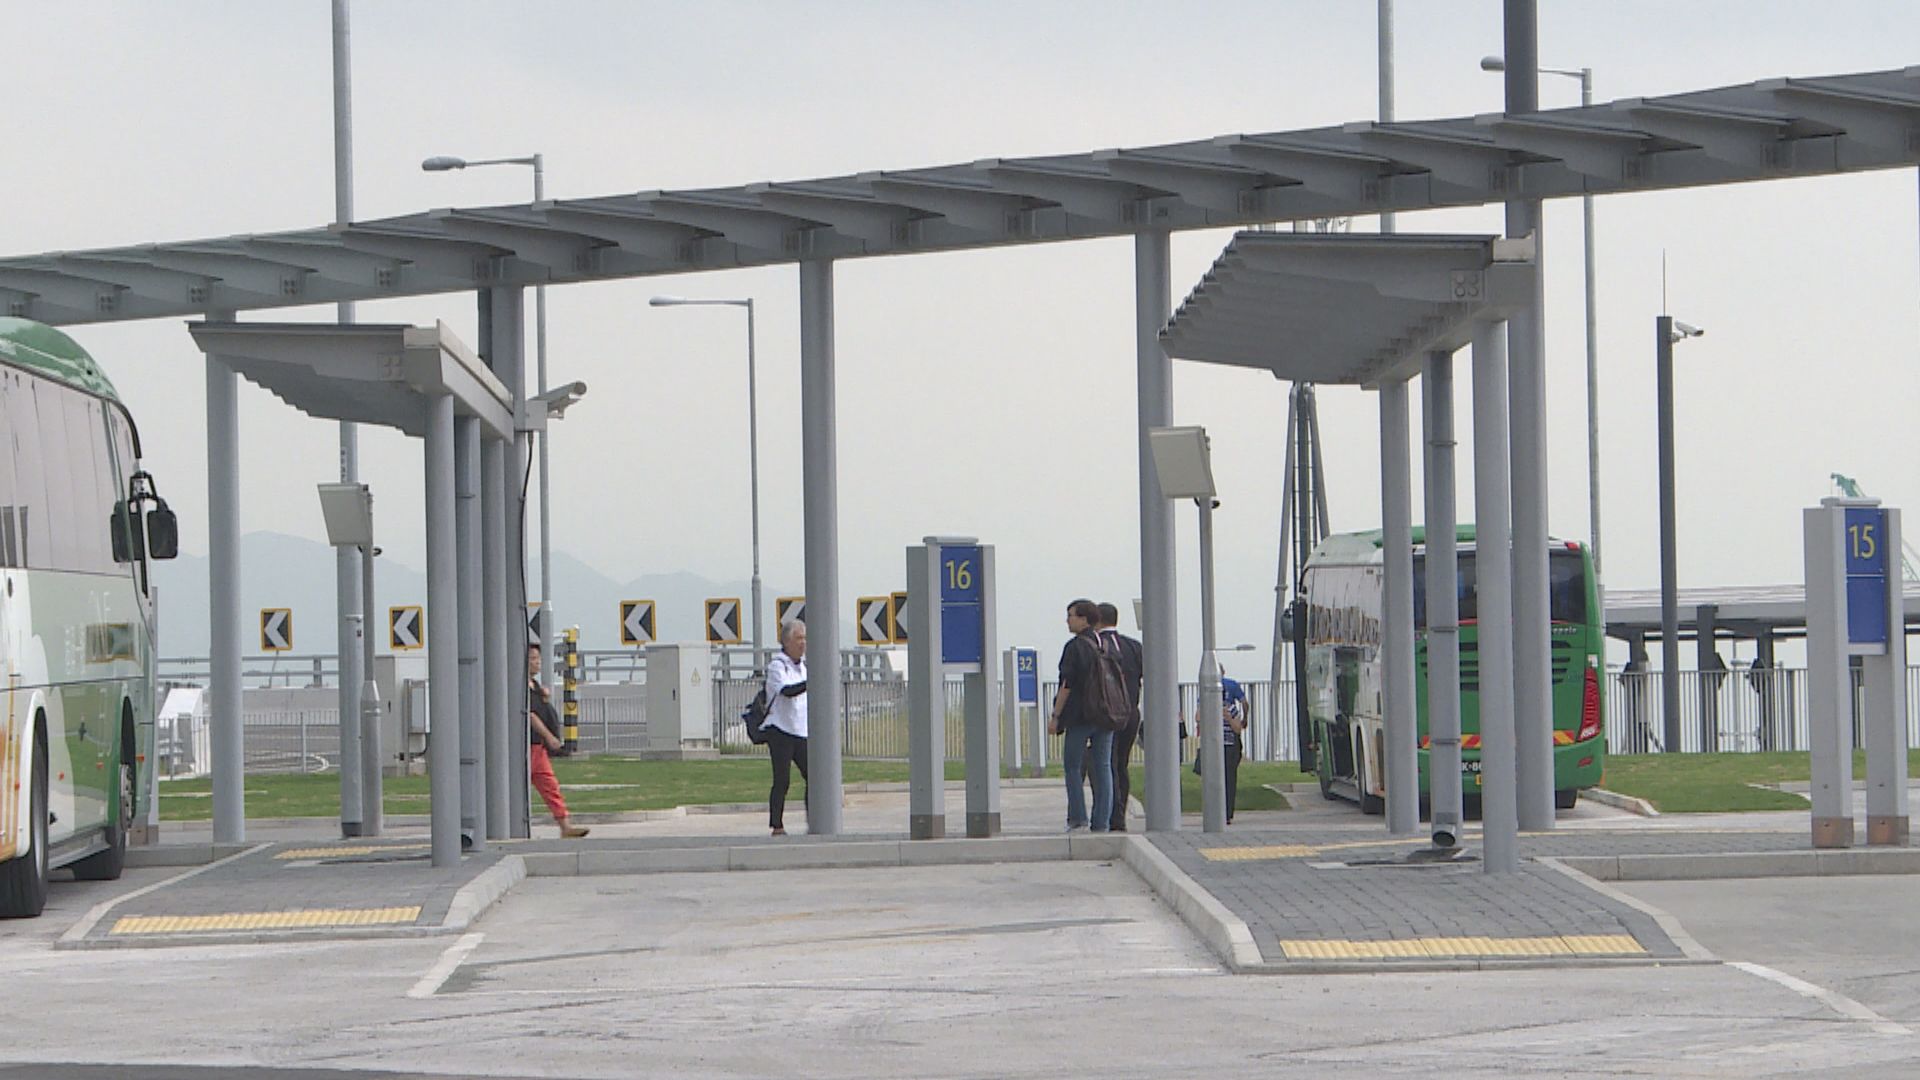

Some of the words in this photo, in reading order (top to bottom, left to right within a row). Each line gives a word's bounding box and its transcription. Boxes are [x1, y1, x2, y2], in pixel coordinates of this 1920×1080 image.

[1849, 525, 1875, 558] 15
[945, 559, 972, 590] 16
[1018, 655, 1033, 671] 32
